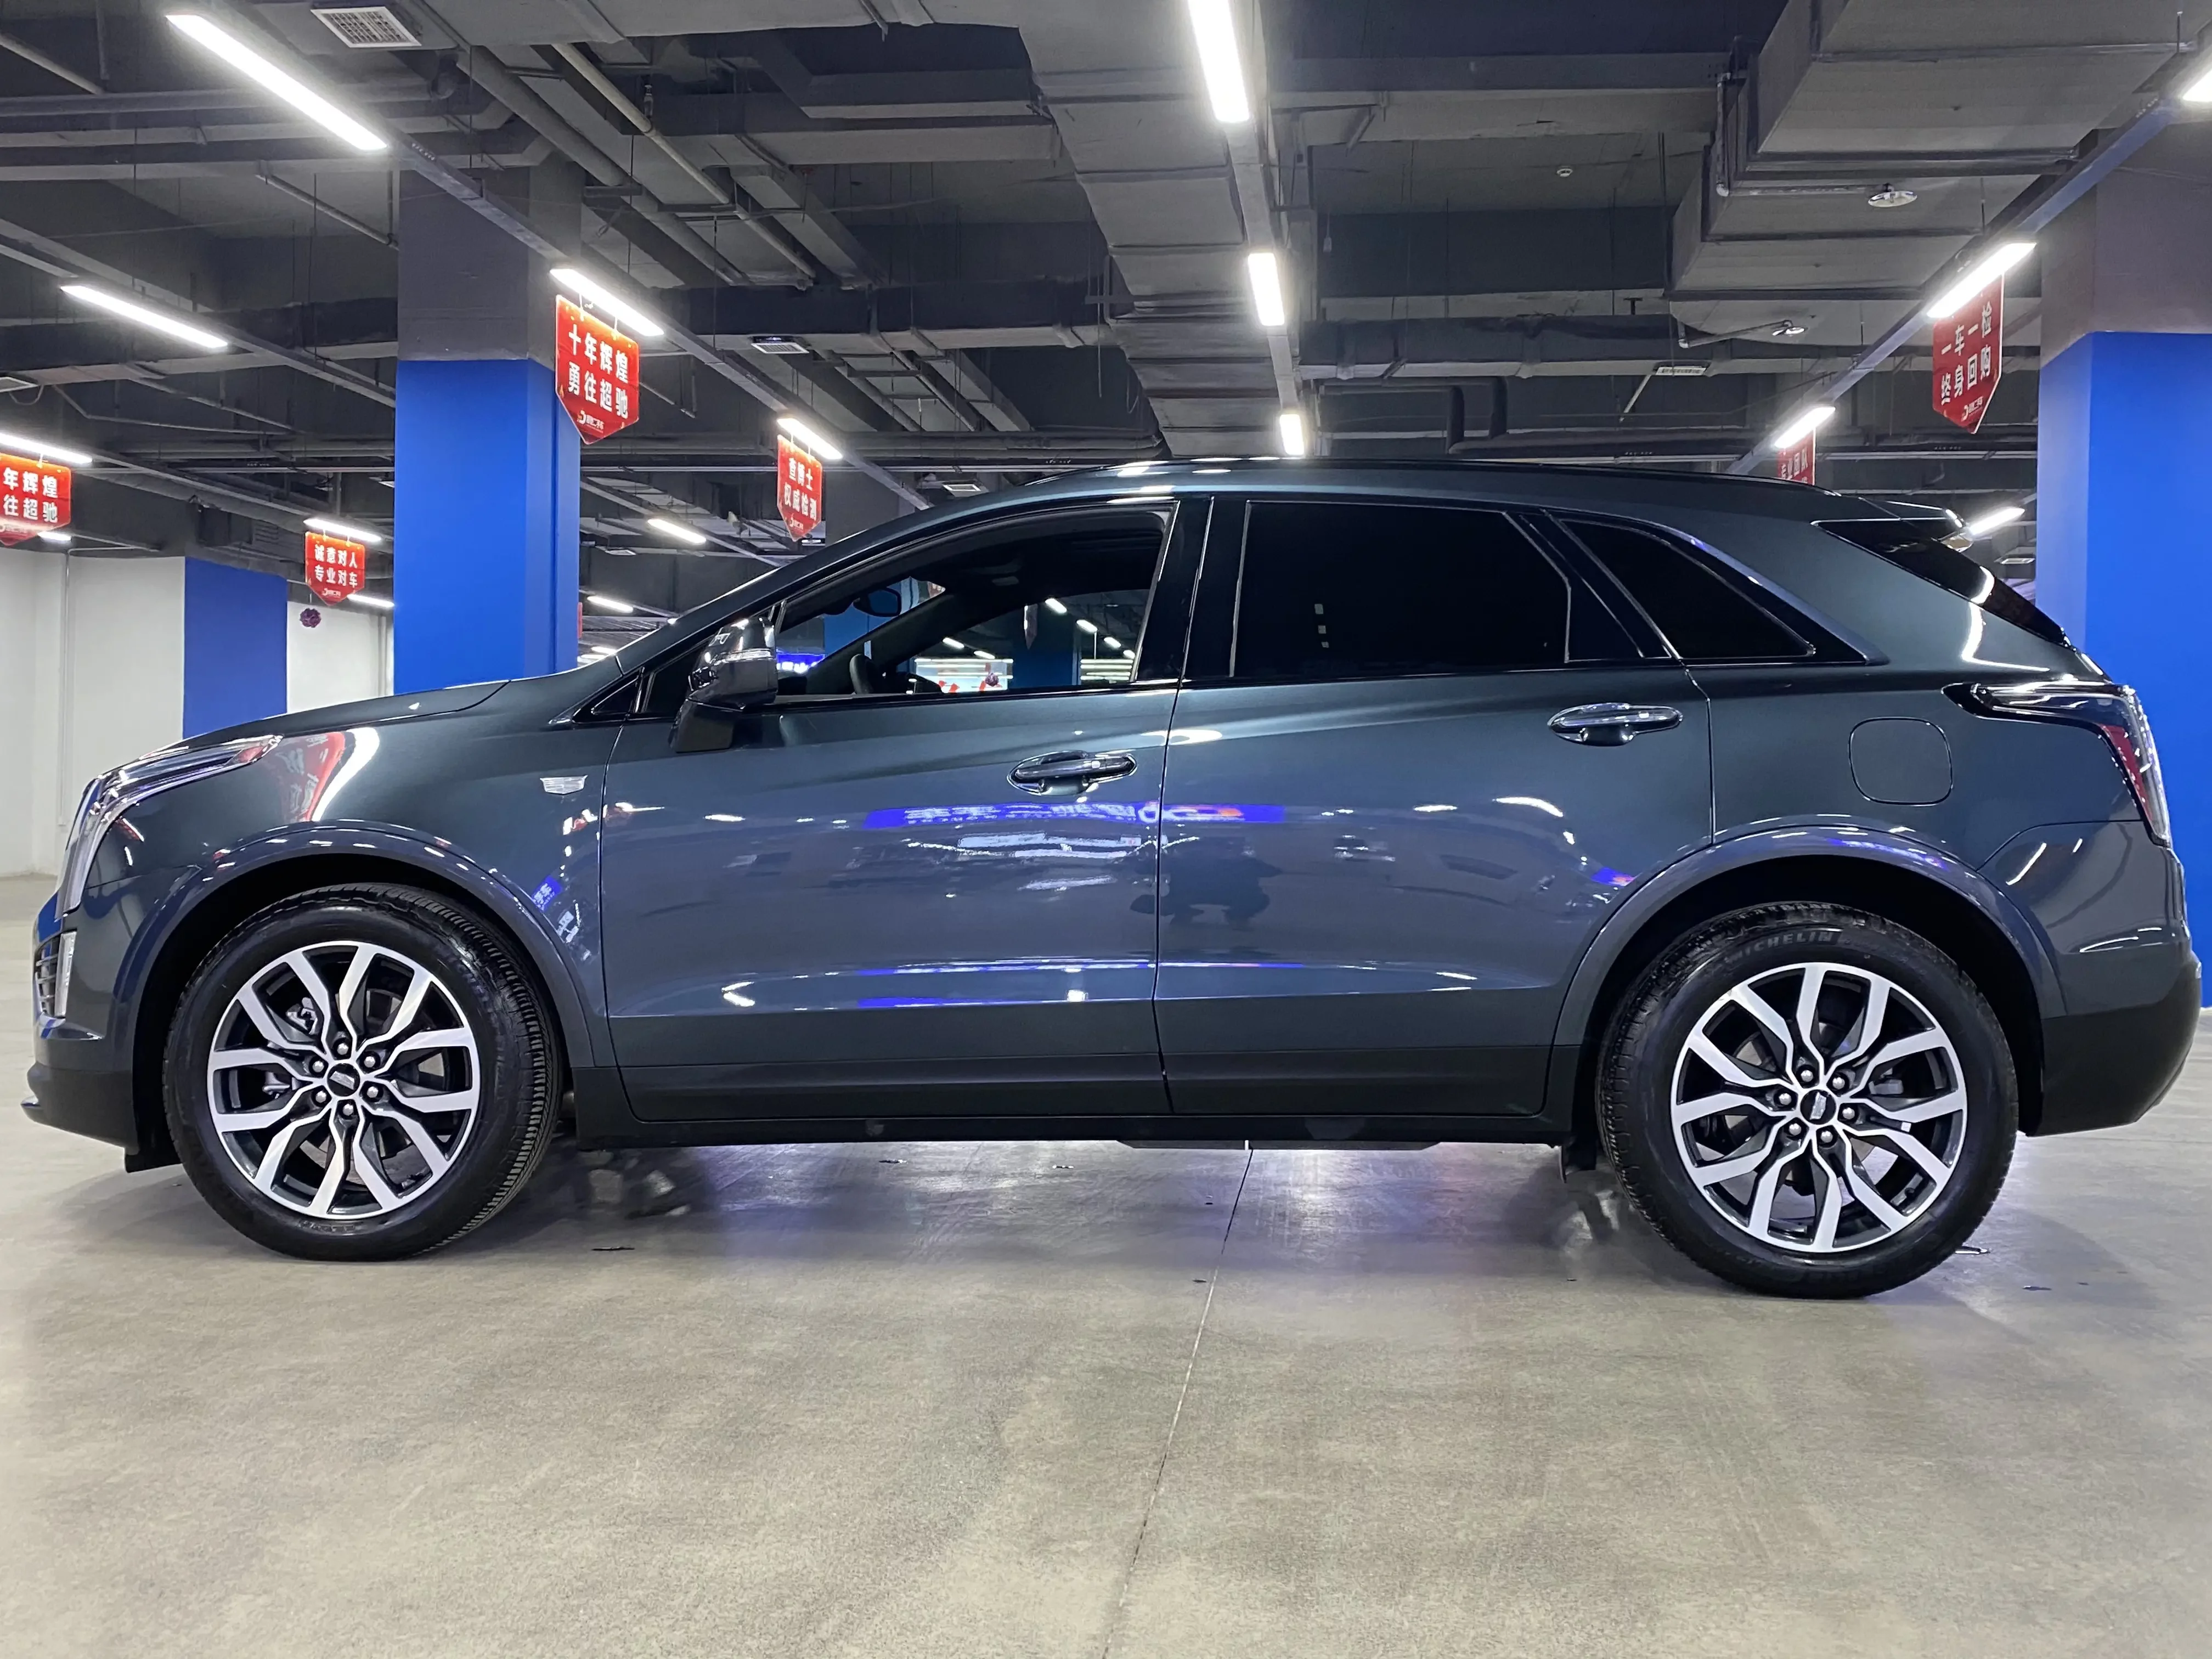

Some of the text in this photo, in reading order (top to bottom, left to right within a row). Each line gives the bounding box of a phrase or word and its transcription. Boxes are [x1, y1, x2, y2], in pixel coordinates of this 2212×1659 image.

[1941, 301, 1992, 356] 一车一检
[568, 323, 628, 383] 十年辉煌
[568, 361, 628, 419] 勇往超驰
[1941, 345, 1991, 406] 终身回购
[3, 467, 58, 498] 年辉煌
[3, 494, 58, 523] 往超驰
[784, 482, 816, 521] 权威检测
[314, 544, 358, 568] 诚意对人
[314, 564, 358, 588] 专业对车
[1724, 931, 1833, 963] MICHELIN
